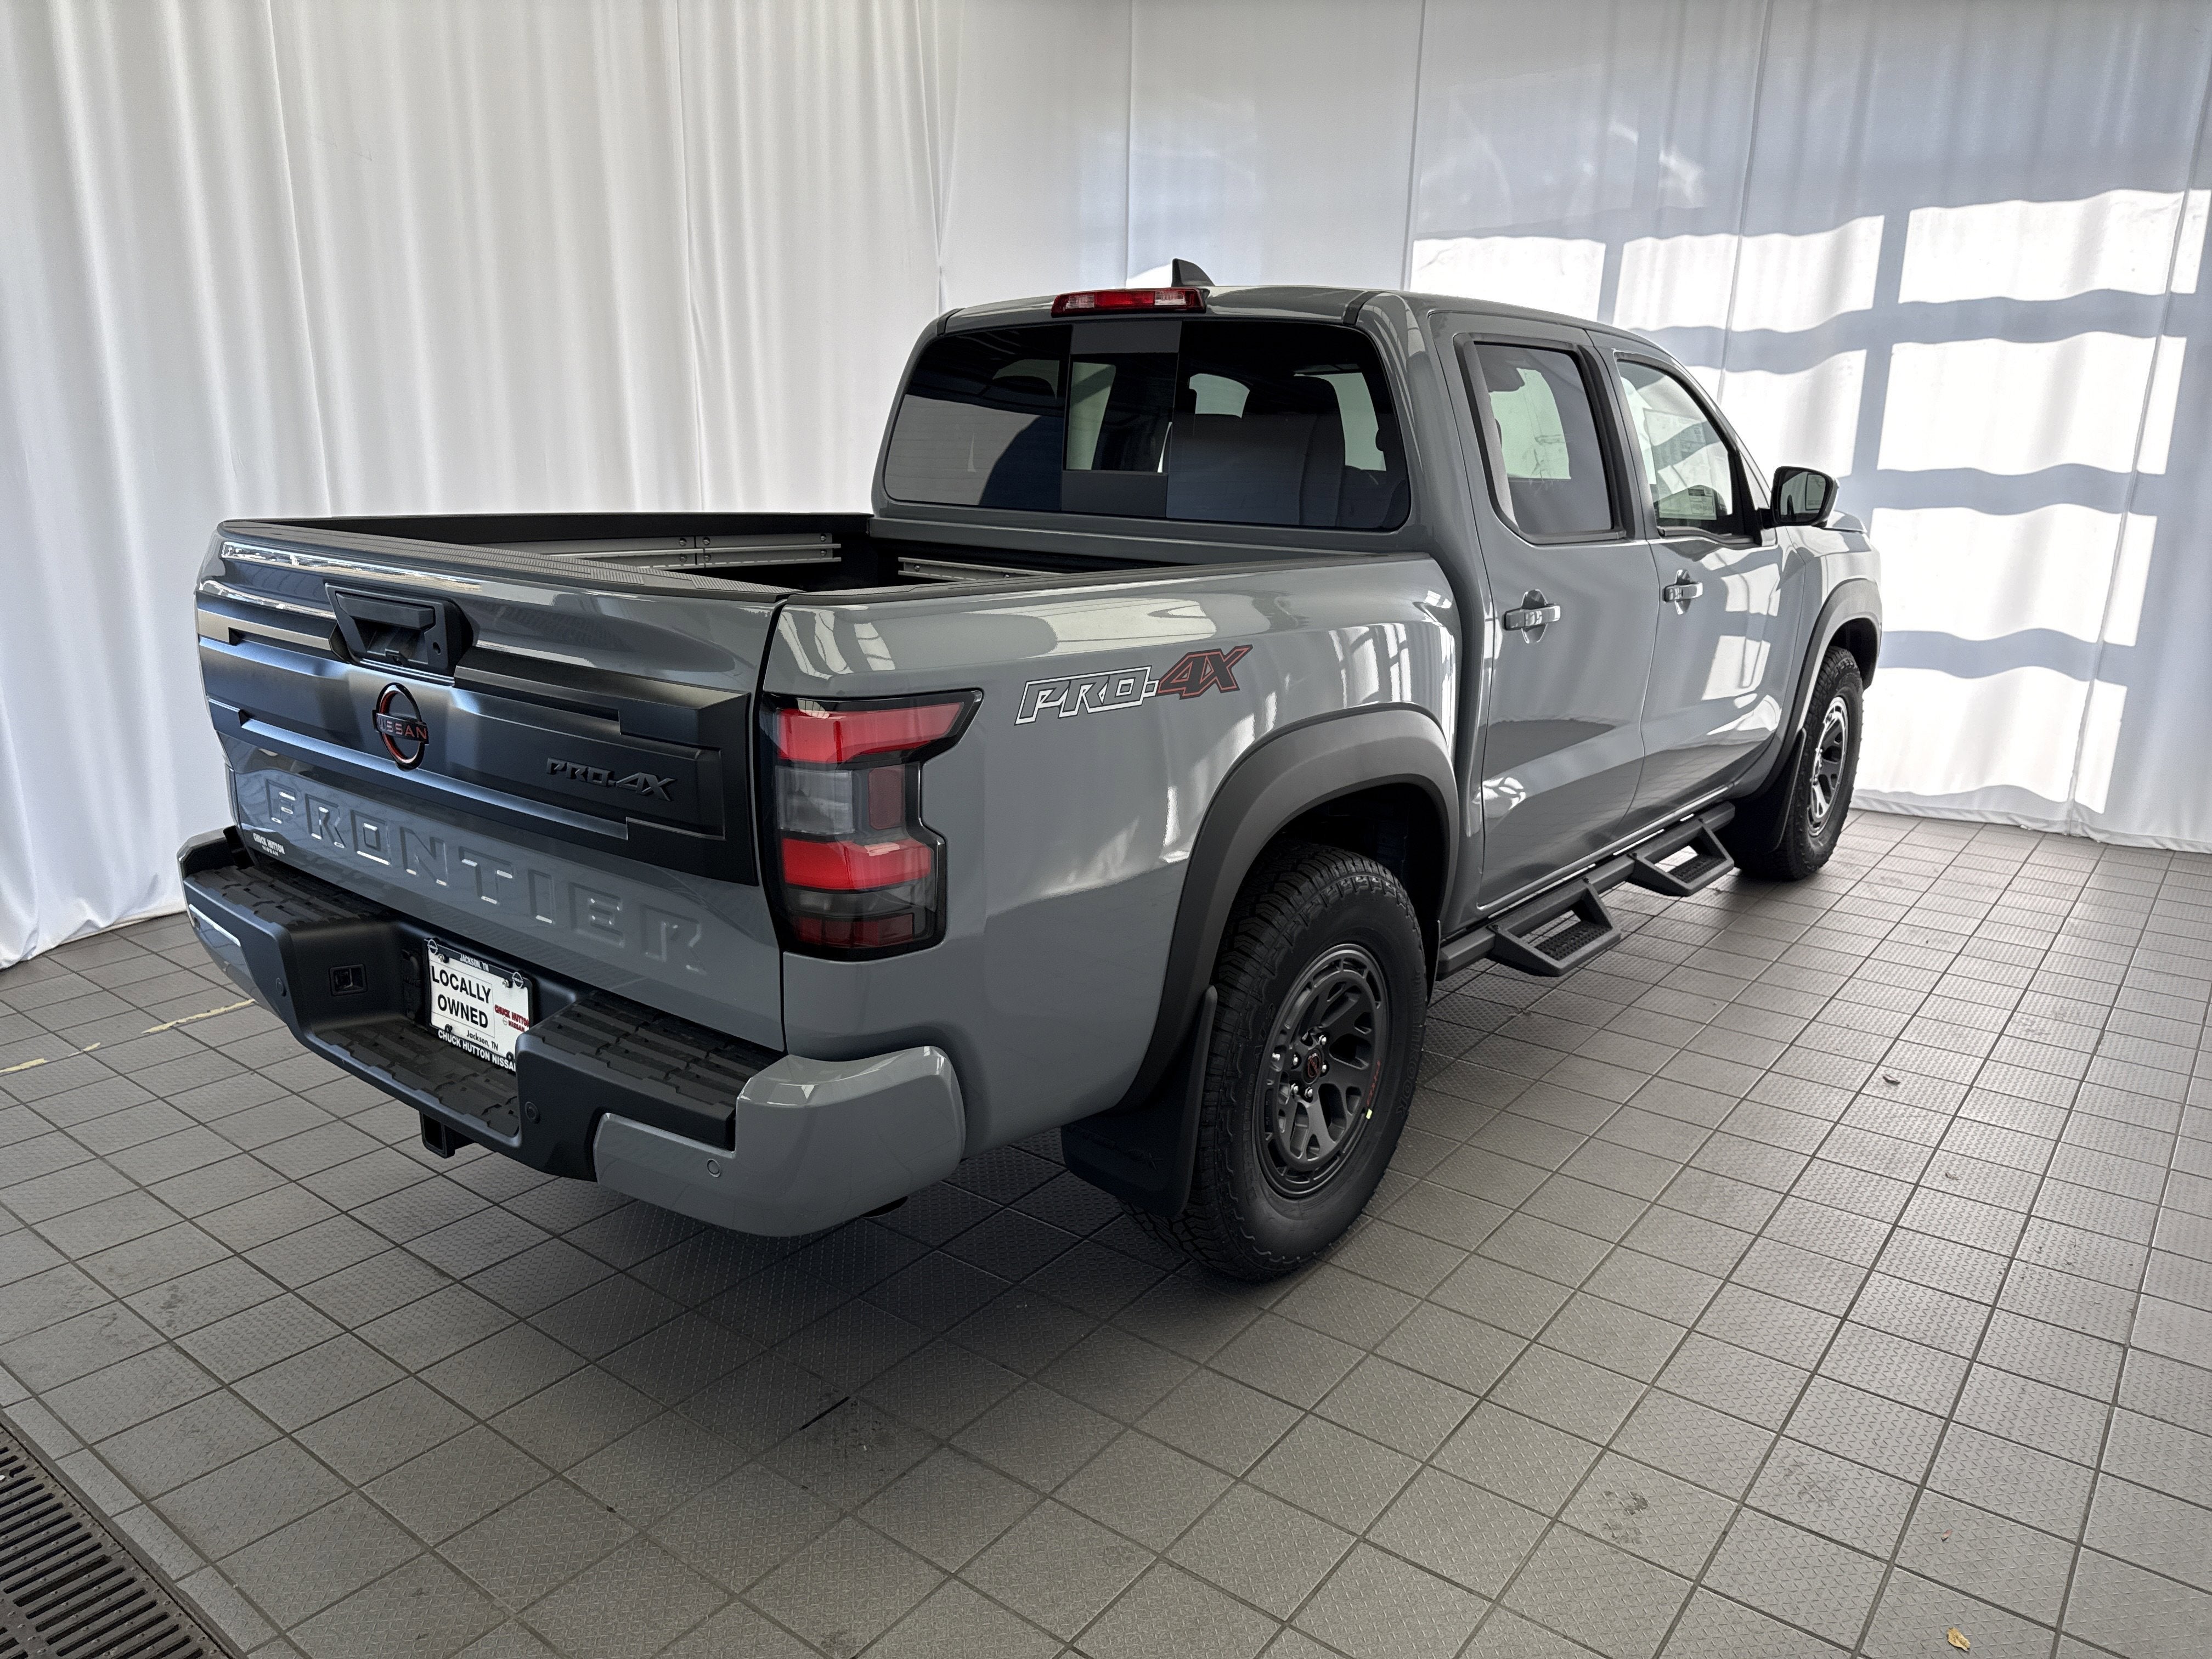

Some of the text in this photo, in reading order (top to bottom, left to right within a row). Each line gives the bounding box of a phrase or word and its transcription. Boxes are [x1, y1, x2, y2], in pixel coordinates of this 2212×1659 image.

[1014, 644, 1254, 726] PRO-4X
[546, 757, 676, 802] PRO-4X
[265, 778, 707, 975] FRONTIER
[460, 953, 489, 972] JACKSON, TN
[431, 965, 491, 1004] LOCALLY
[438, 994, 488, 1028] OWNED
[494, 1004, 511, 1019] CHUCK
[438, 1030, 461, 1048] CHUCK
[462, 1040, 490, 1062] HUTTON
[466, 1030, 499, 1051] Jackson, TN
